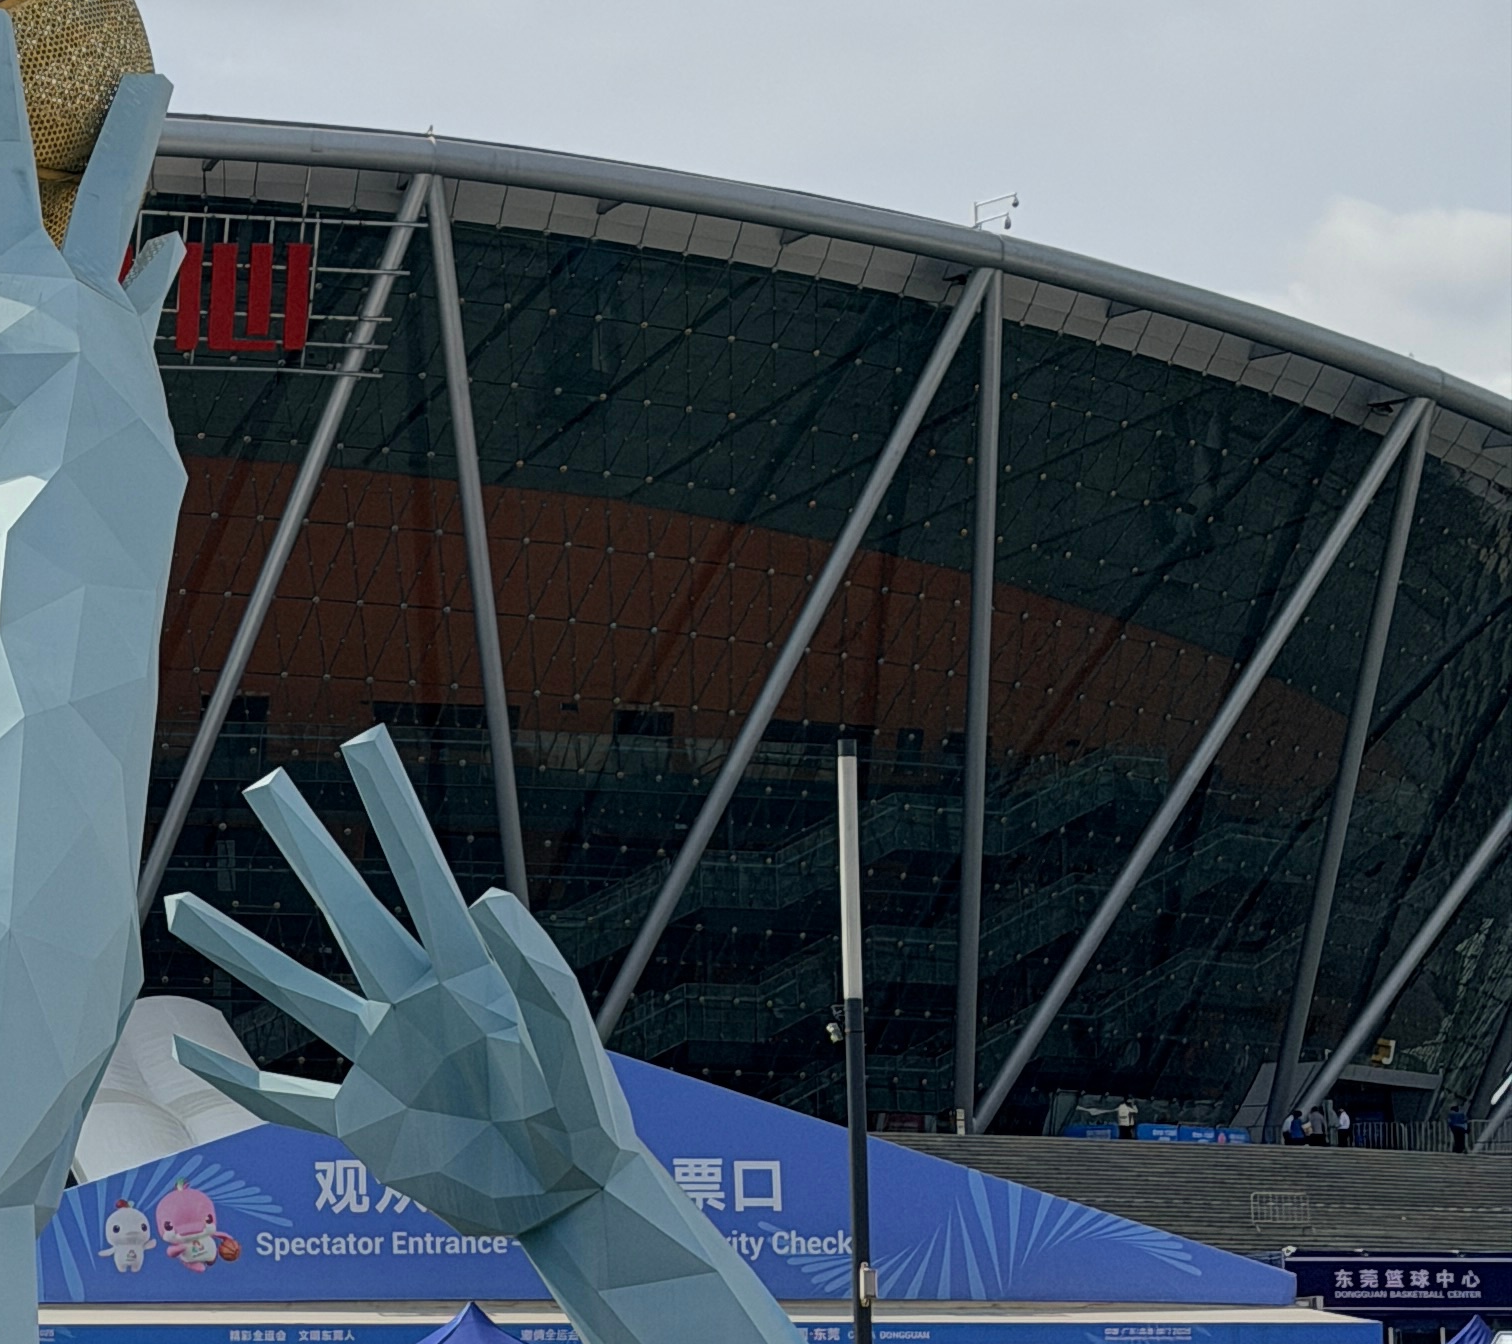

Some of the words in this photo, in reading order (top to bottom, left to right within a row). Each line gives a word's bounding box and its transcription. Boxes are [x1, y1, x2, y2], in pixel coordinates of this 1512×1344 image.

[256, 1231, 384, 1261] Spectator
[772, 1229, 854, 1255] Check
[1334, 1268, 1481, 1289] 东莞篮球中心
[1334, 1290, 1388, 1299] DONGGUAN
[1389, 1290, 1445, 1299] BASKETBALL
[1447, 1290, 1482, 1299] CENTER
[879, 1330, 931, 1340] DONGGUAN
